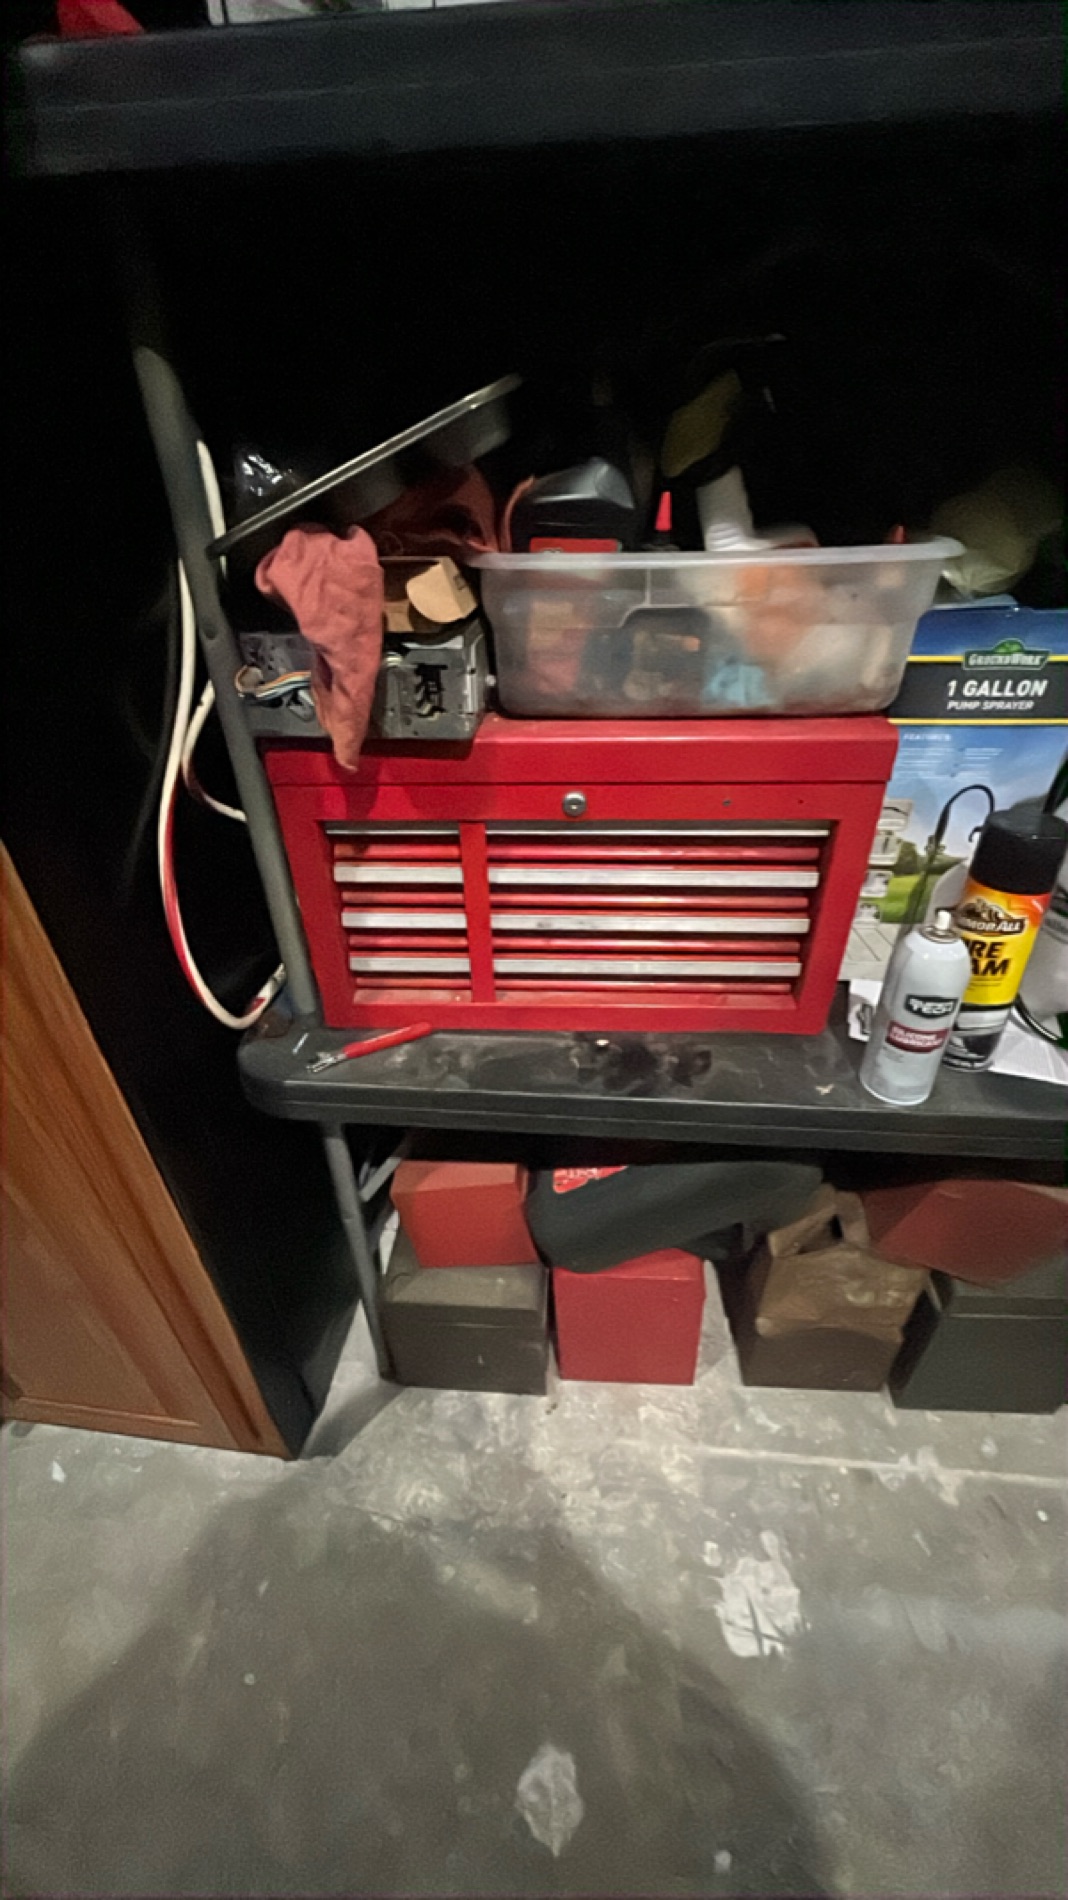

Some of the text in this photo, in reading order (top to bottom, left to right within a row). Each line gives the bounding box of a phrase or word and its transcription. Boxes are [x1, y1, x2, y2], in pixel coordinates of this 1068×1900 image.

[946, 679, 1048, 697] 1 GALLON
[947, 700, 1035, 710] PUMP SPRAYER
[970, 958, 1012, 977] AM
